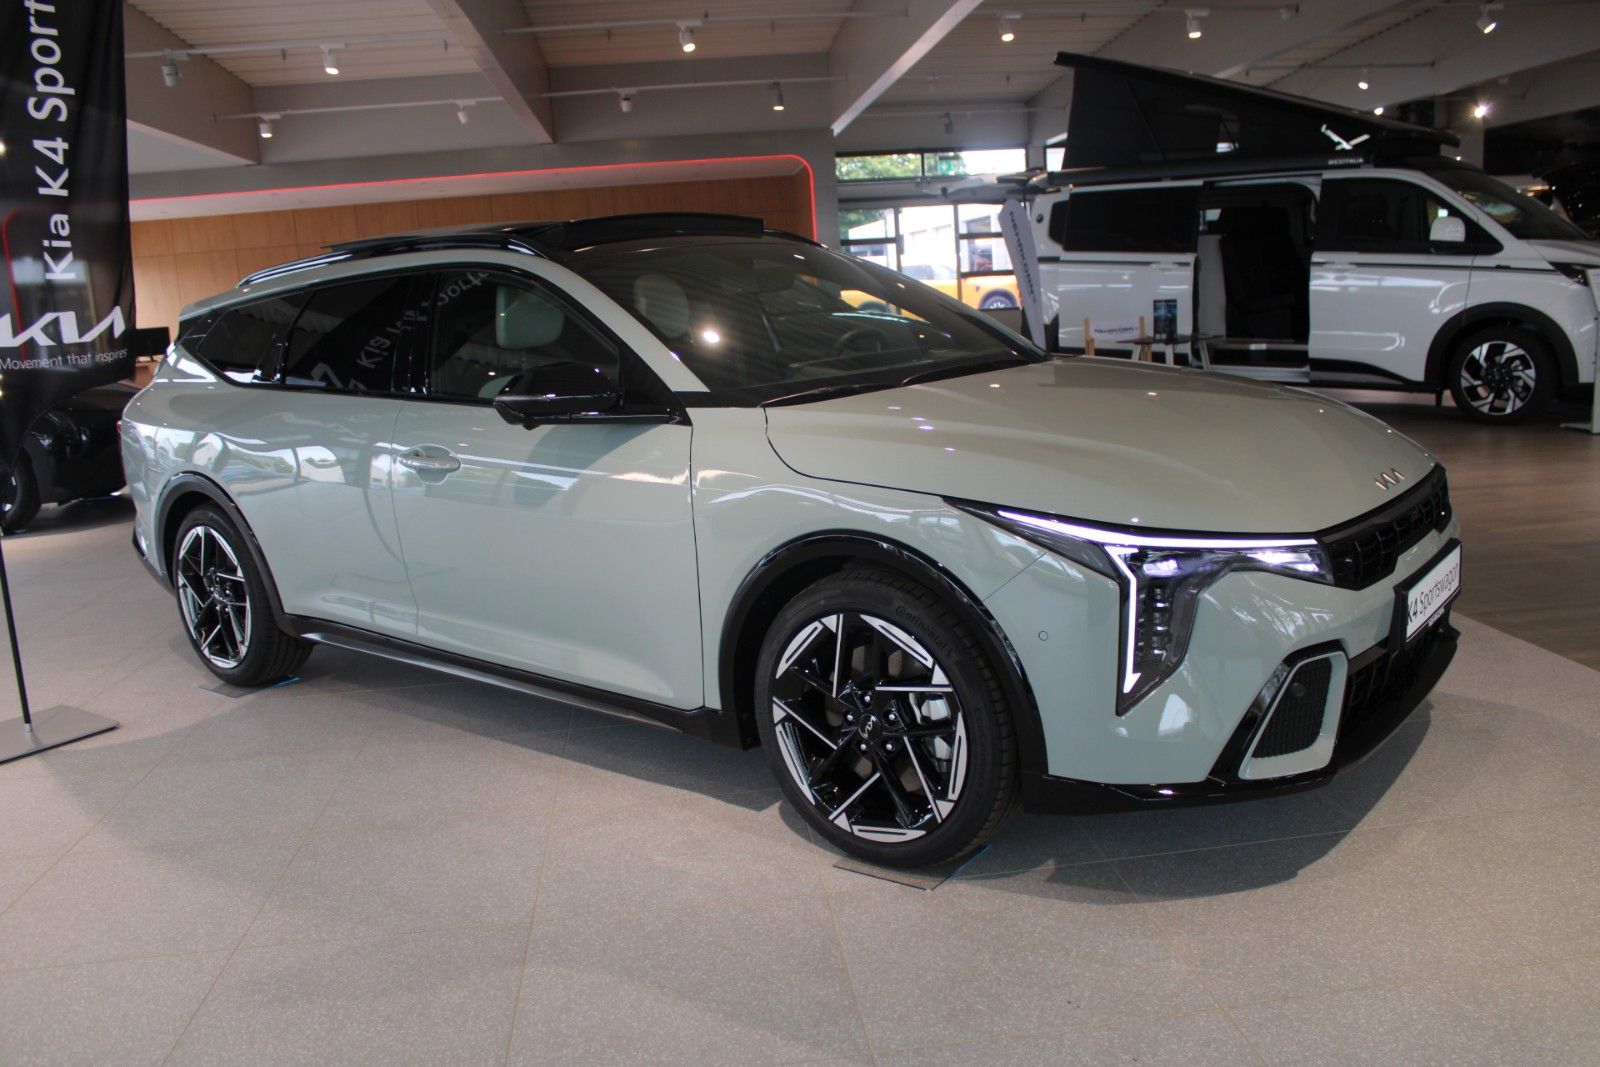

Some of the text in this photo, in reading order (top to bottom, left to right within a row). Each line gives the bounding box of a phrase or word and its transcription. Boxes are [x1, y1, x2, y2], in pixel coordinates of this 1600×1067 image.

[33, 136, 69, 197] K4
[43, 213, 76, 280] Kia
[0, 354, 63, 370] Movement
[67, 352, 92, 366] that
